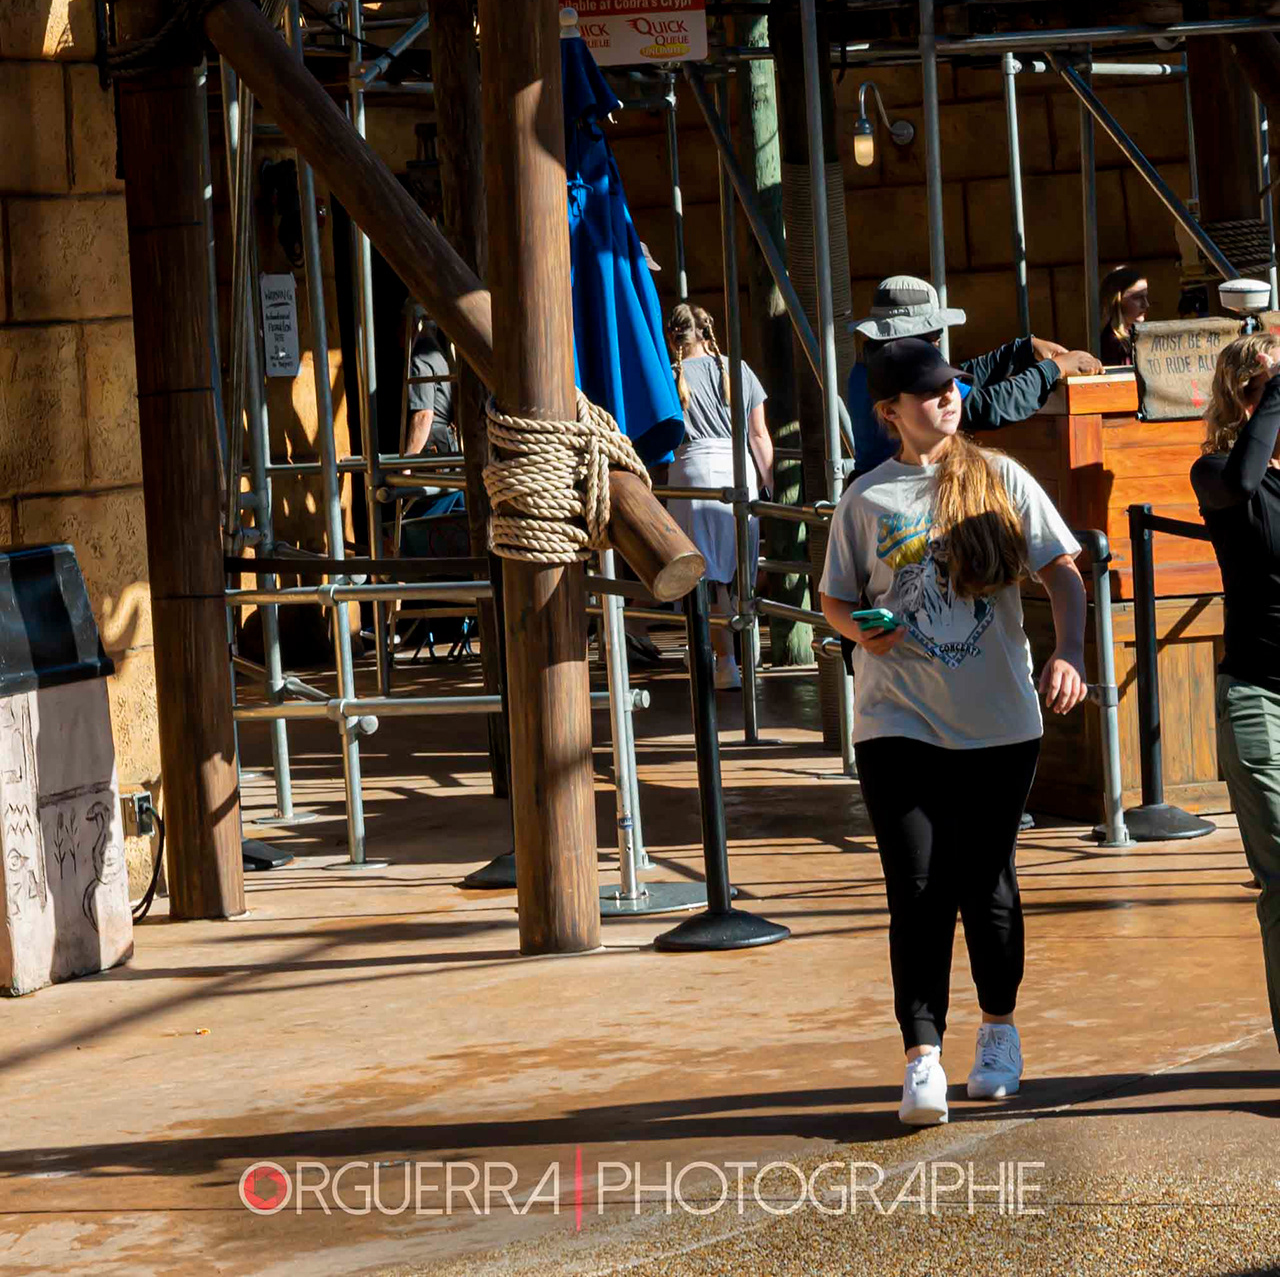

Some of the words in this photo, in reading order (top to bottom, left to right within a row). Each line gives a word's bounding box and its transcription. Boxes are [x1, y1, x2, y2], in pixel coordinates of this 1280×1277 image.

[1151, 334, 1184, 352] MUST
[1188, 332, 1201, 349] BE
[1148, 358, 1162, 375] TO
[1166, 356, 1191, 374] RIDE
[938, 642, 982, 658] CONCERT
